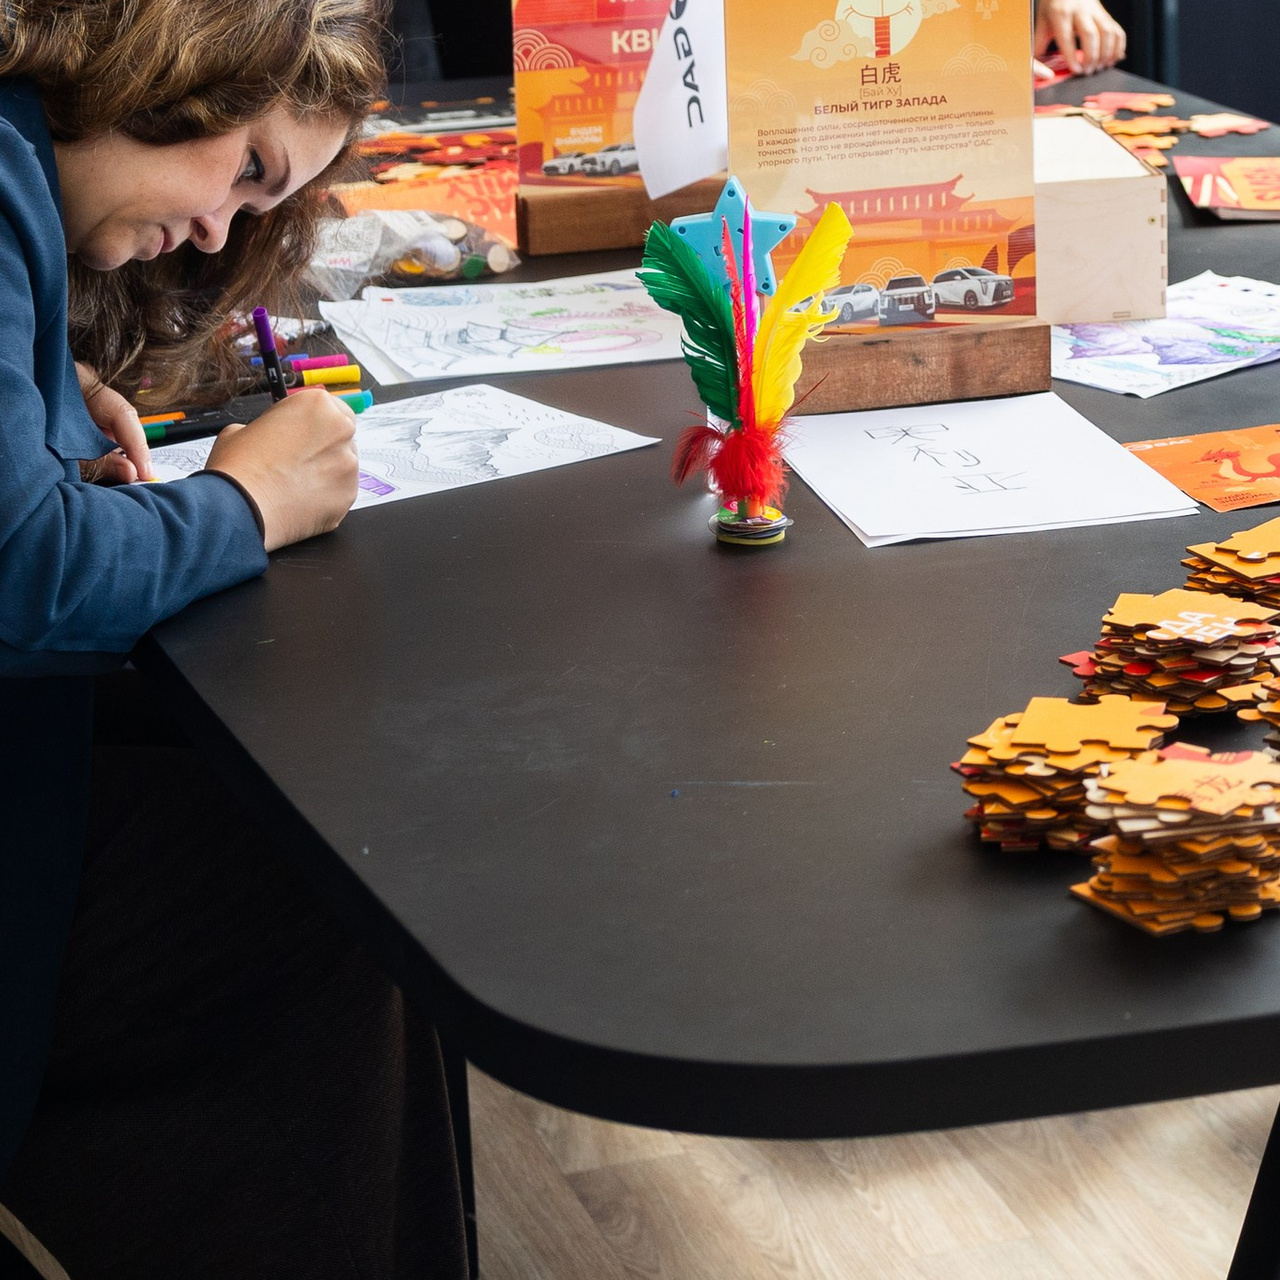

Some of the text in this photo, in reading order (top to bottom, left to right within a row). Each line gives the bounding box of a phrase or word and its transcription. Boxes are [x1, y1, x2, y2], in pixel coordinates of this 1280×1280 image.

[861, 62, 901, 86] 白虎
[860, 84, 902, 99] [Бай Ху]
[814, 95, 947, 115] БЕЛЫЙ ТИГР ЗАПАДА
[757, 125, 815, 137] Воплощение
[843, 115, 929, 131] сосредоточенности
[938, 110, 996, 121] дисциплины.
[766, 137, 800, 146] каждом
[818, 132, 864, 142] движении
[883, 127, 913, 135] ничего
[915, 123, 954, 132] лишнего
[966, 119, 994, 127] только
[800, 145, 812, 153] Но
[929, 132, 970, 142] результат
[972, 128, 1008, 138] долгого,
[757, 157, 800, 169] упорного
[826, 152, 847, 161] Тигр
[848, 148, 893, 159] открывает
